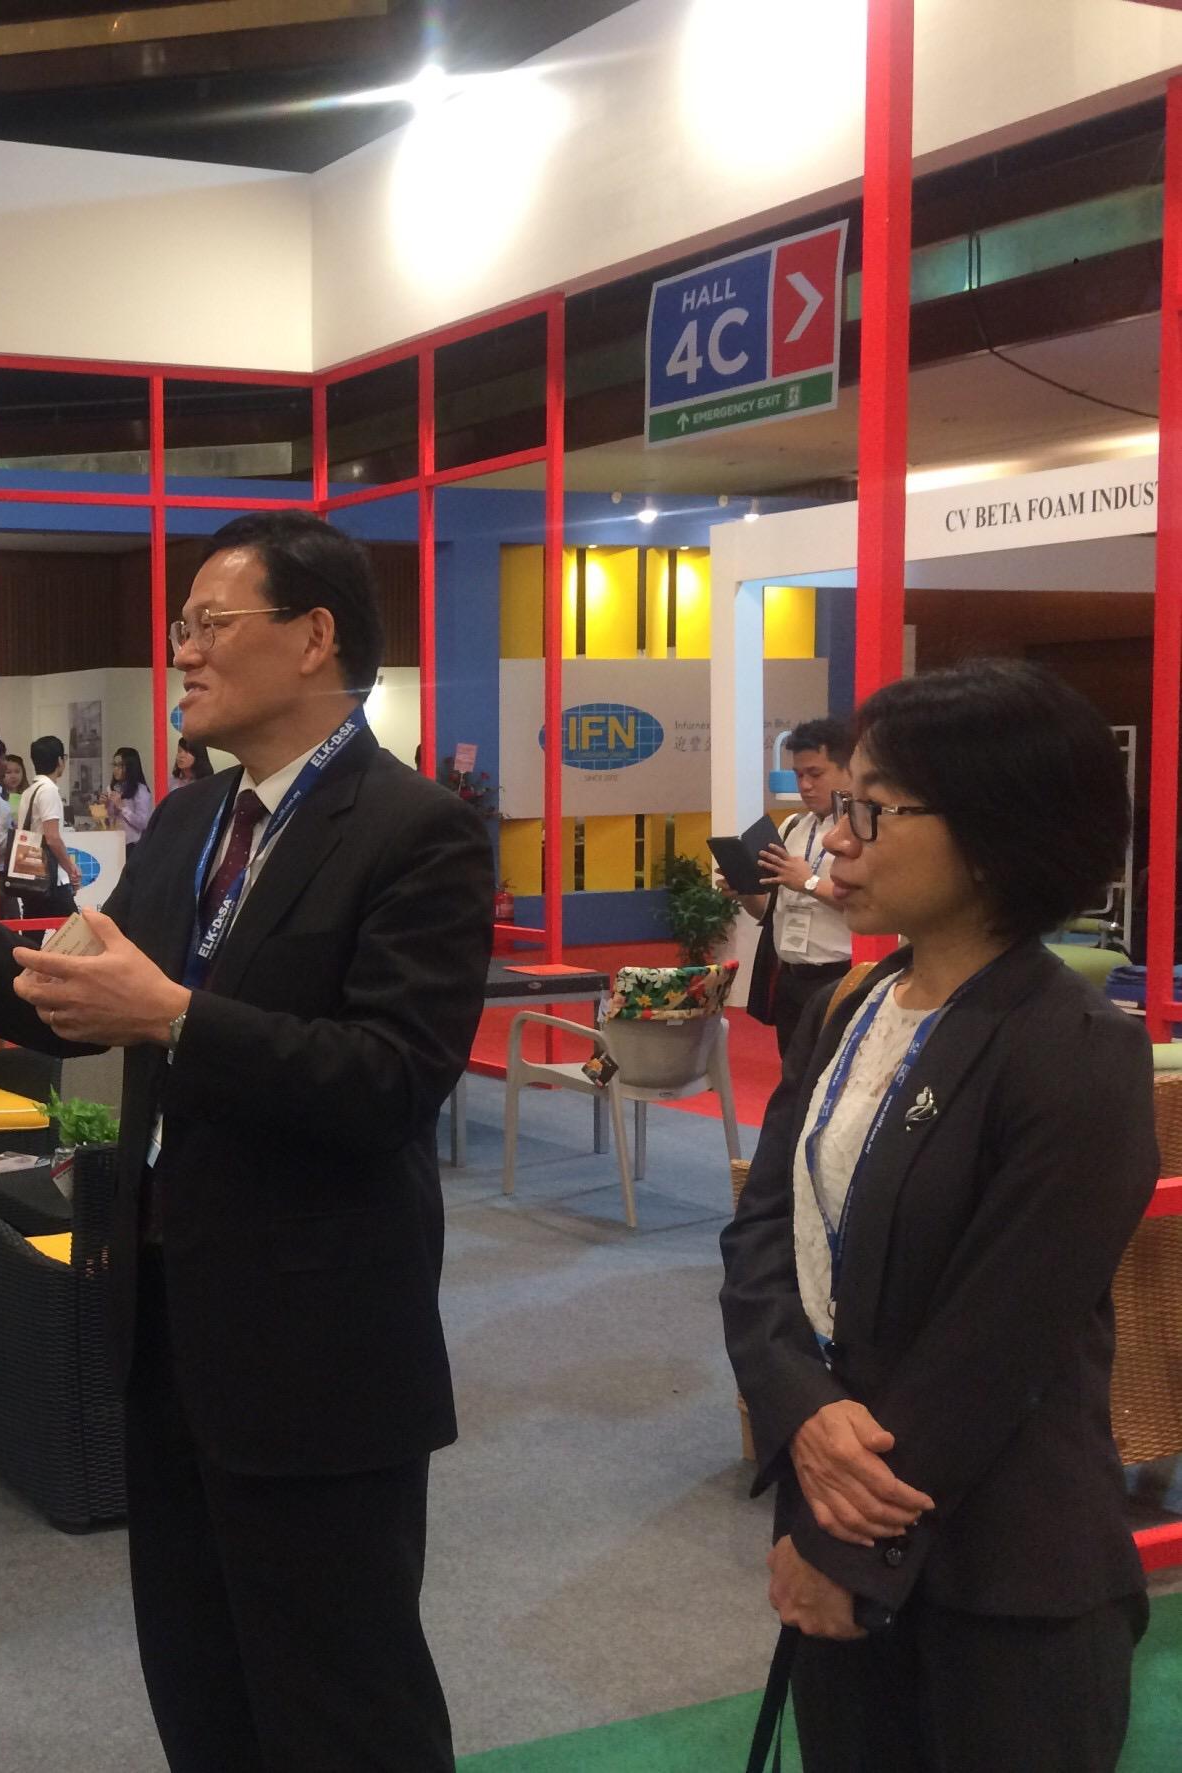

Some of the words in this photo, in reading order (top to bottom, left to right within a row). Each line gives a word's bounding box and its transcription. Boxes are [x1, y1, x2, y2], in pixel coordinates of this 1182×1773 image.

[682, 278, 736, 313] HALL
[666, 307, 749, 384] 4C
[693, 399, 754, 424] EMERGENCY
[757, 393, 782, 409] EXIT
[945, 508, 970, 532] CV
[975, 502, 1021, 528] BETA
[1028, 491, 1085, 521] FOAM
[1091, 481, 1159, 513] INDUS
[568, 715, 636, 750] IFN
